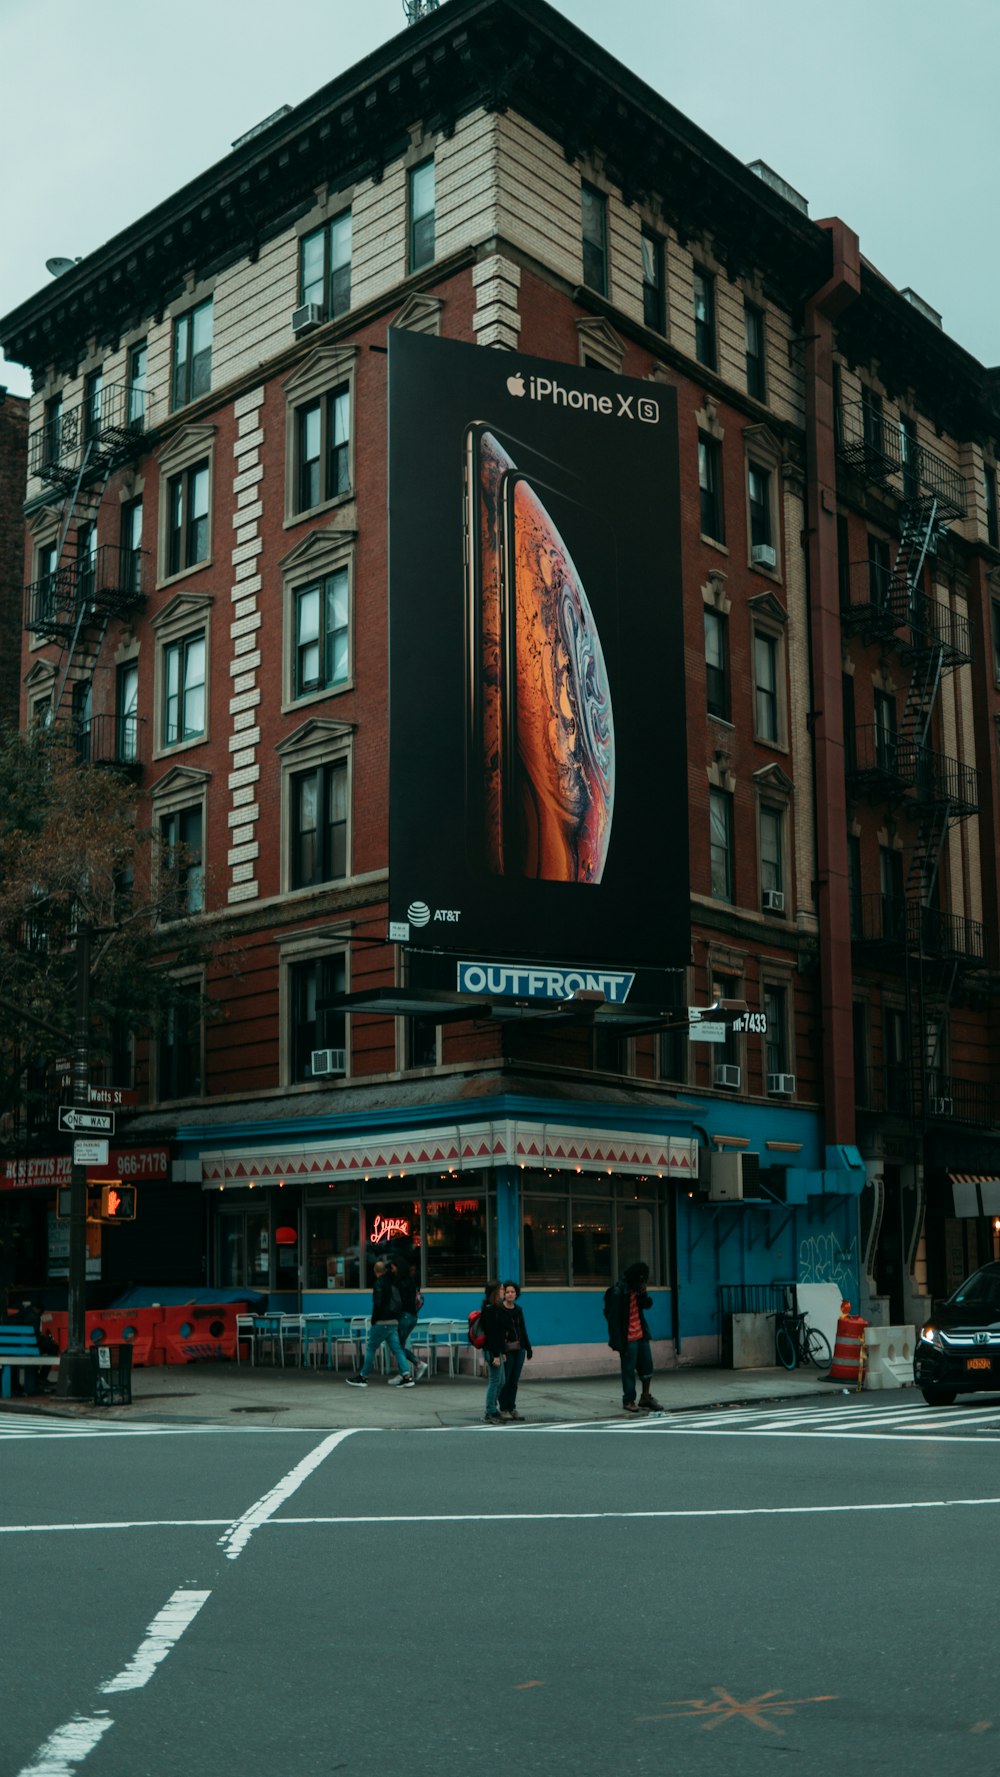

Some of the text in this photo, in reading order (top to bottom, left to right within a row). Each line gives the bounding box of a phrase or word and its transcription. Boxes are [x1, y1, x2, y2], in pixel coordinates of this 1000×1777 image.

[529, 375, 613, 415] iPhone
[616, 393, 635, 420] X
[433, 909, 461, 922] AT&T
[464, 966, 625, 1001] OUTFRONT
[90, 1089, 122, 1104] Watts St
[68, 1115, 107, 1127] ONE WAY
[56, 1156, 72, 1175] PIZ
[117, 1152, 167, 1175] 966-7178
